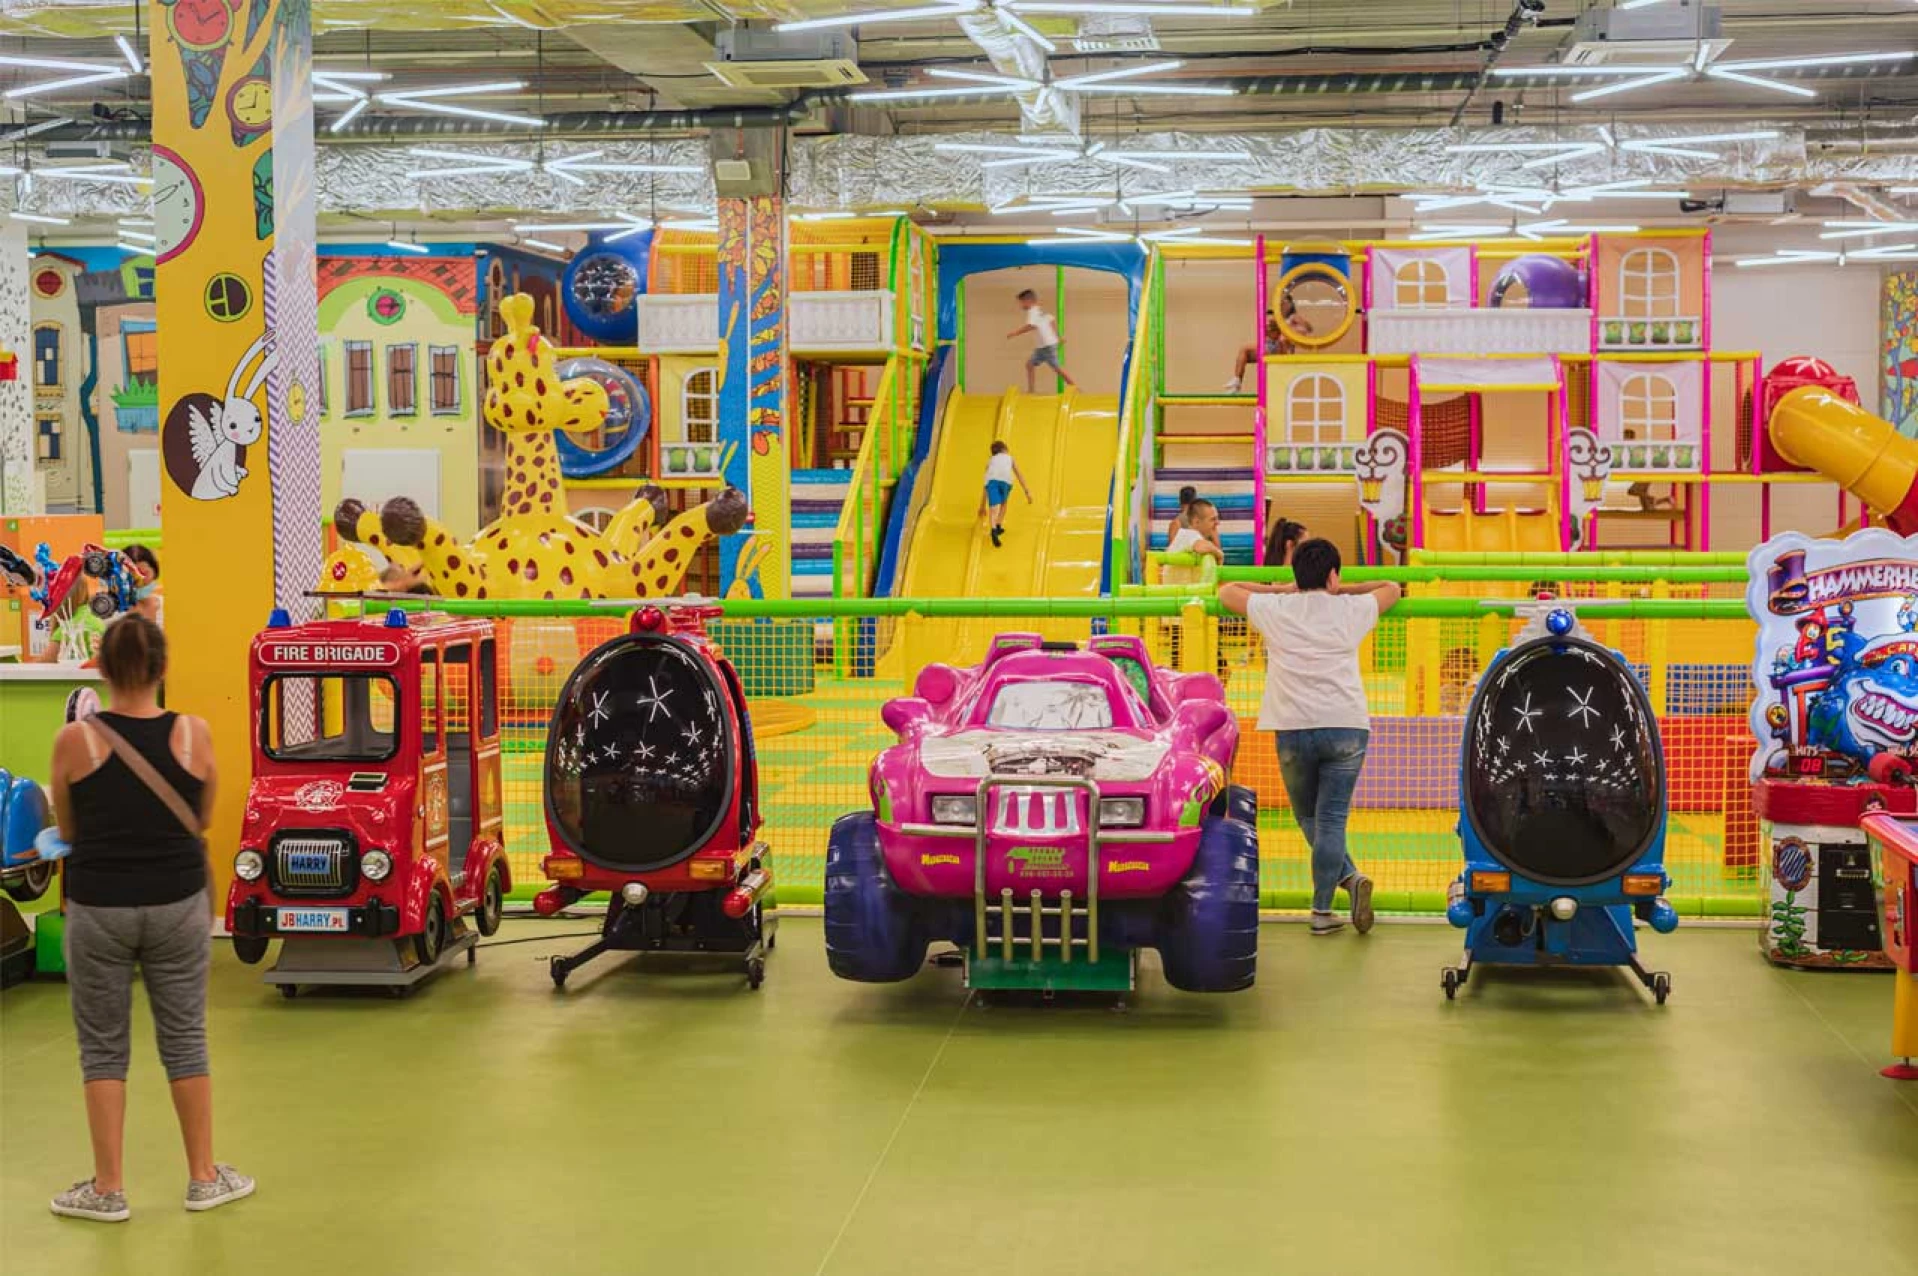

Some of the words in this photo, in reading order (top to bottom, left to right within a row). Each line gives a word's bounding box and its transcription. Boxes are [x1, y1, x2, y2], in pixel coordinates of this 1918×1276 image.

[273, 645, 309, 661] FIRE
[314, 645, 385, 661] BRIGADE
[1801, 758, 1822, 772] 08
[291, 856, 326, 870] HARRY
